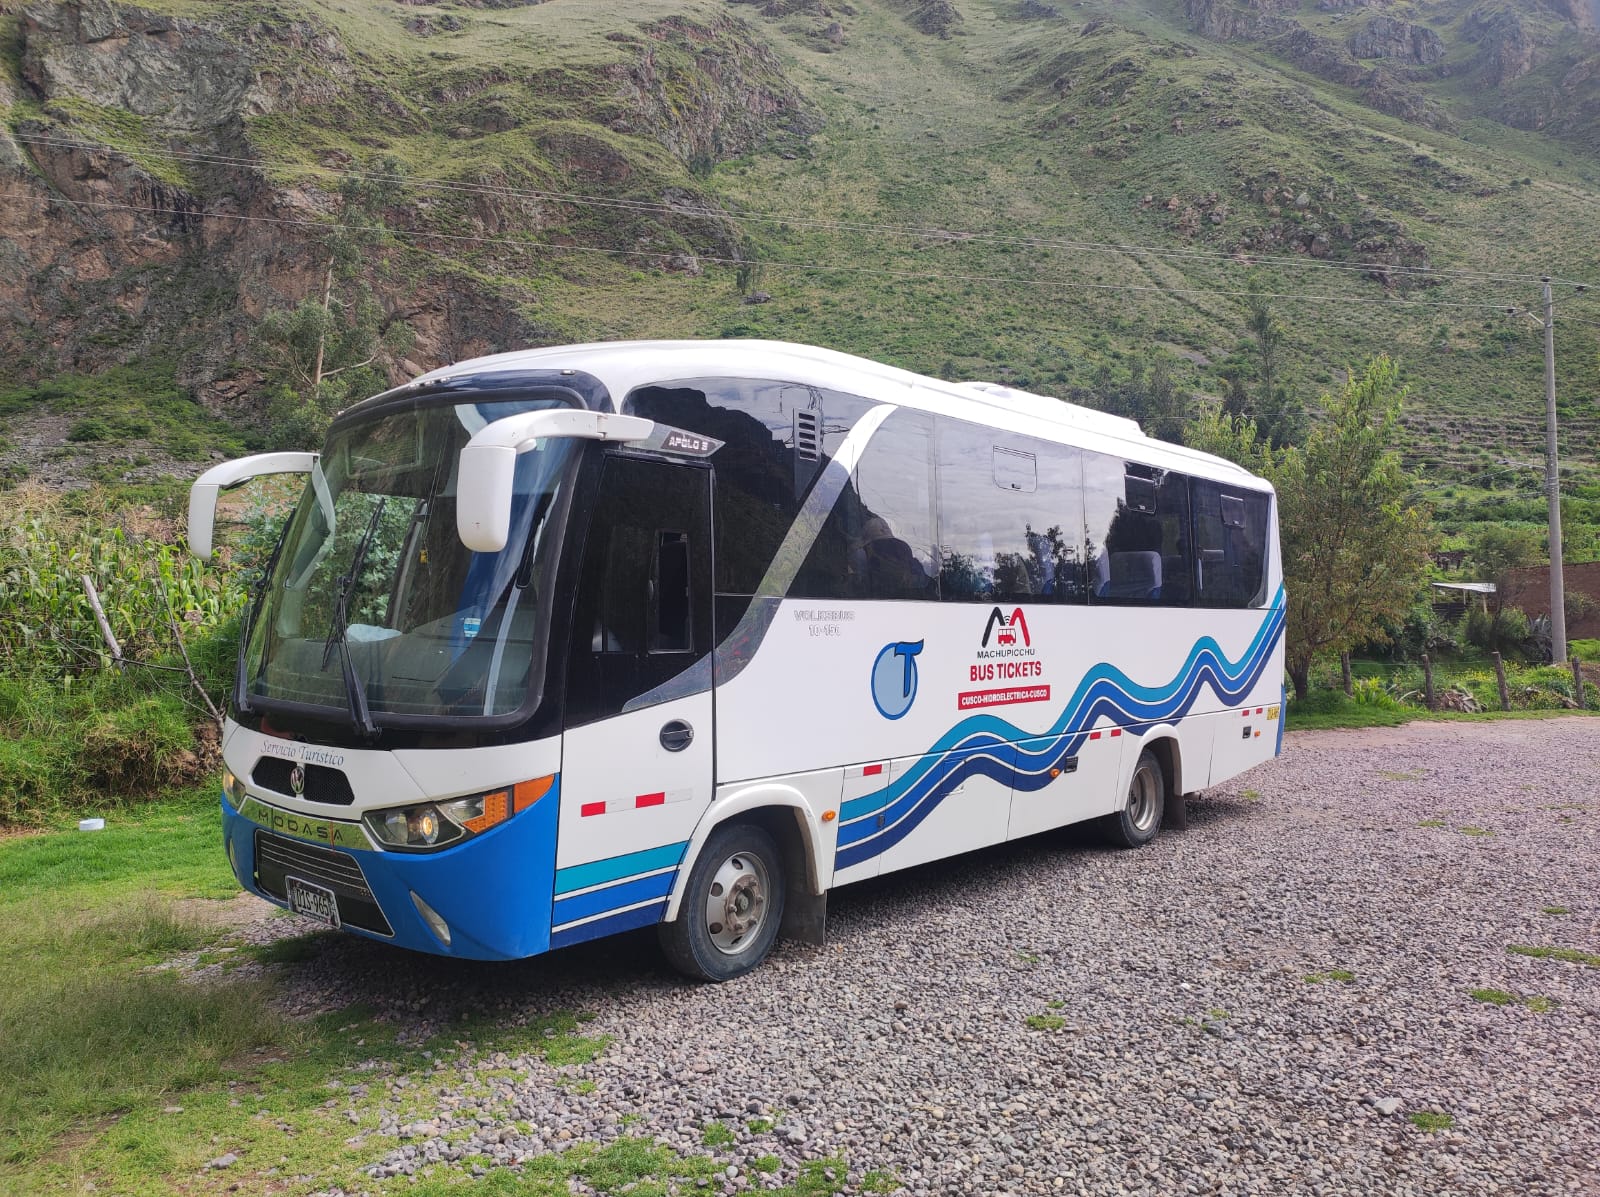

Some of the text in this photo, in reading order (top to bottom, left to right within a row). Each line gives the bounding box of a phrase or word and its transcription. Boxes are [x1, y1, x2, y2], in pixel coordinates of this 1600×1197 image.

[669, 436, 699, 450] APOLO
[793, 610, 855, 621] VOLKSBUS
[977, 649, 1035, 659] MACHUPICCHU
[970, 661, 1042, 681] BUS TICKETS
[261, 740, 297, 758] Servicio
[258, 810, 343, 841] MODASA
